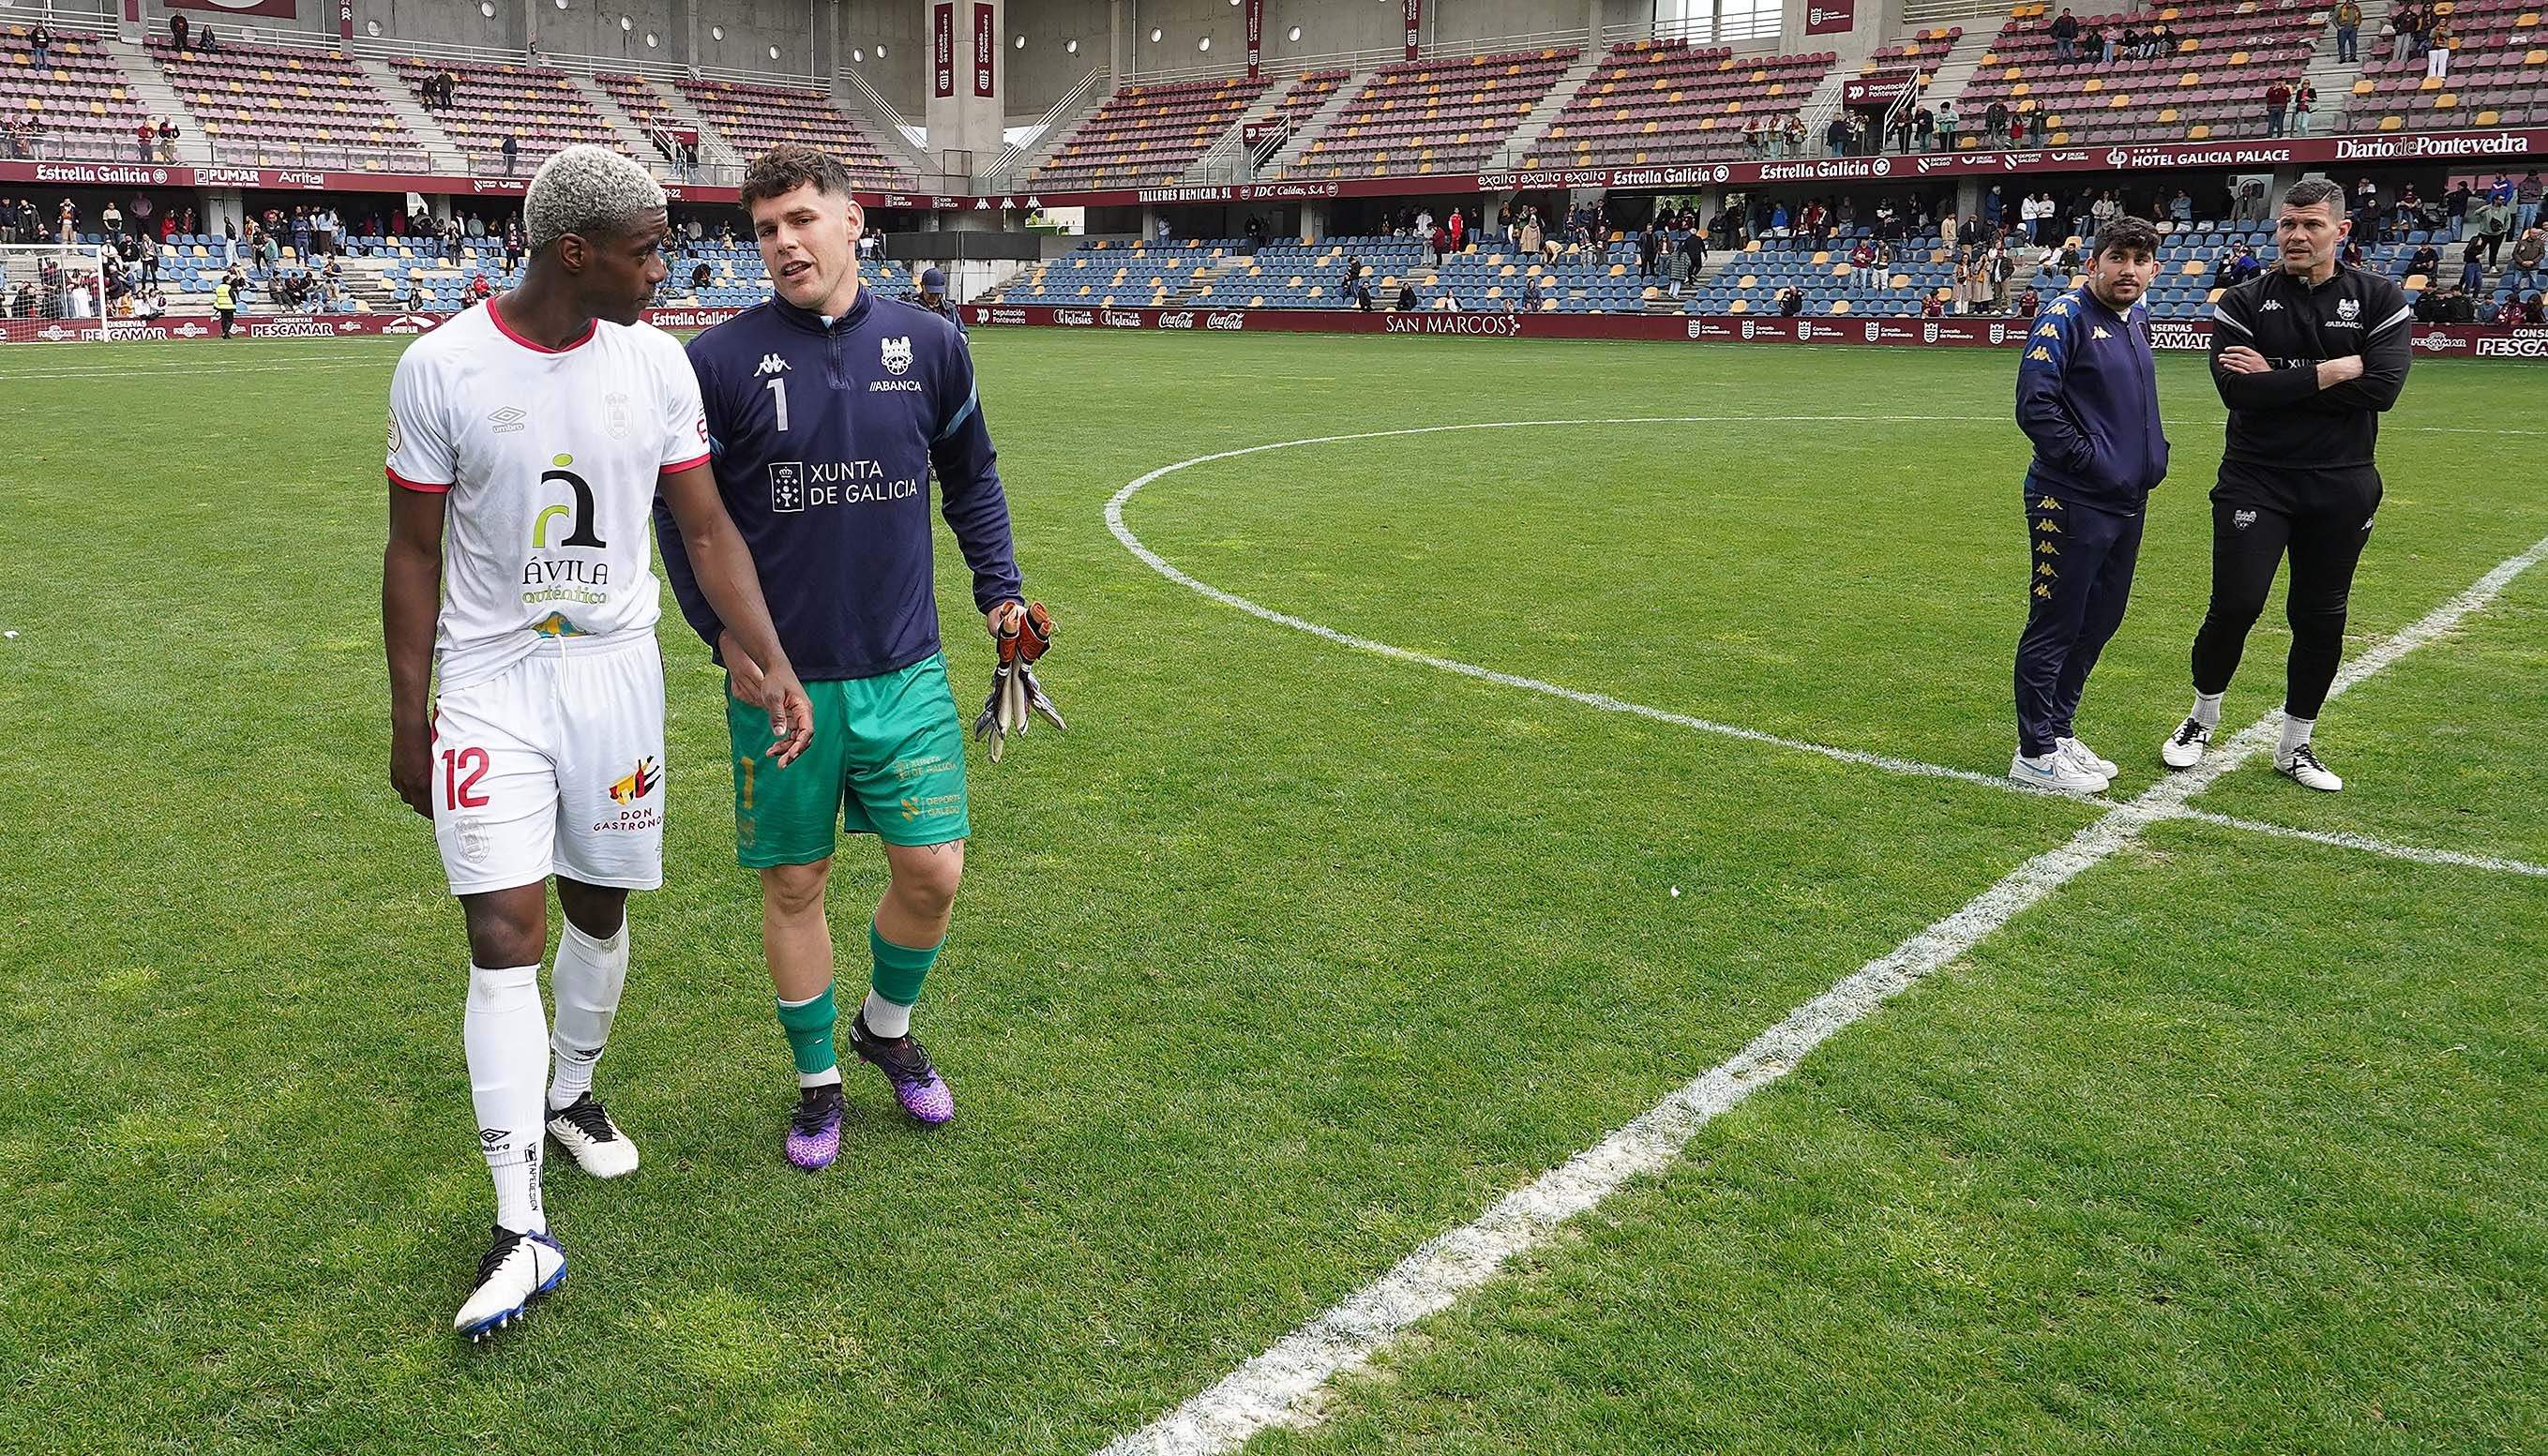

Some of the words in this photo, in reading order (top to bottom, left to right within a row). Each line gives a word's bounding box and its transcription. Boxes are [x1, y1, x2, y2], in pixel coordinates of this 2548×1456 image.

[2132, 155, 2175, 167] HOTEL
[2177, 152, 2232, 165] GALICIA
[2236, 150, 2290, 163] PALACE
[36, 165, 95, 183] Estrella
[97, 167, 150, 186] Galicia
[208, 170, 260, 183] PUMAR
[1613, 170, 1662, 186] Estrella
[1664, 168, 1711, 183] Galicia
[1759, 163, 1815, 179] Estrella
[1817, 160, 1869, 176] Galicia
[278, 172, 324, 186] Arrital
[1477, 174, 1516, 187] exalta
[1520, 173, 1561, 186] exalta
[1564, 171, 1606, 185] exalta
[1138, 189, 1178, 203] TALLERES
[1181, 188, 1220, 202] HEMICAR,
[1221, 187, 1232, 200] SL
[1253, 186, 1276, 197] IDC
[1276, 186, 1306, 196] Caldas,
[1307, 185, 1325, 194] S.A.
[651, 311, 696, 326] Estrella
[992, 308, 1026, 318] Deputación
[992, 317, 1026, 325] Pontevedra
[1386, 315, 1420, 332] SAN
[1425, 316, 1507, 334] MARCOS
[81, 327, 169, 342] PECAMAR
[251, 323, 336, 338] PESCAMAR
[766, 378, 789, 431] 1
[493, 423, 525, 433] umbro
[809, 459, 884, 483] XUNTA
[810, 486, 838, 505] DE
[845, 478, 918, 503] GALICIA
[522, 557, 609, 585] ÁVILA
[521, 583, 609, 606] auténtica
[442, 746, 490, 811] 12
[620, 808, 653, 821] DON
[482, 1143, 510, 1153] mbro
